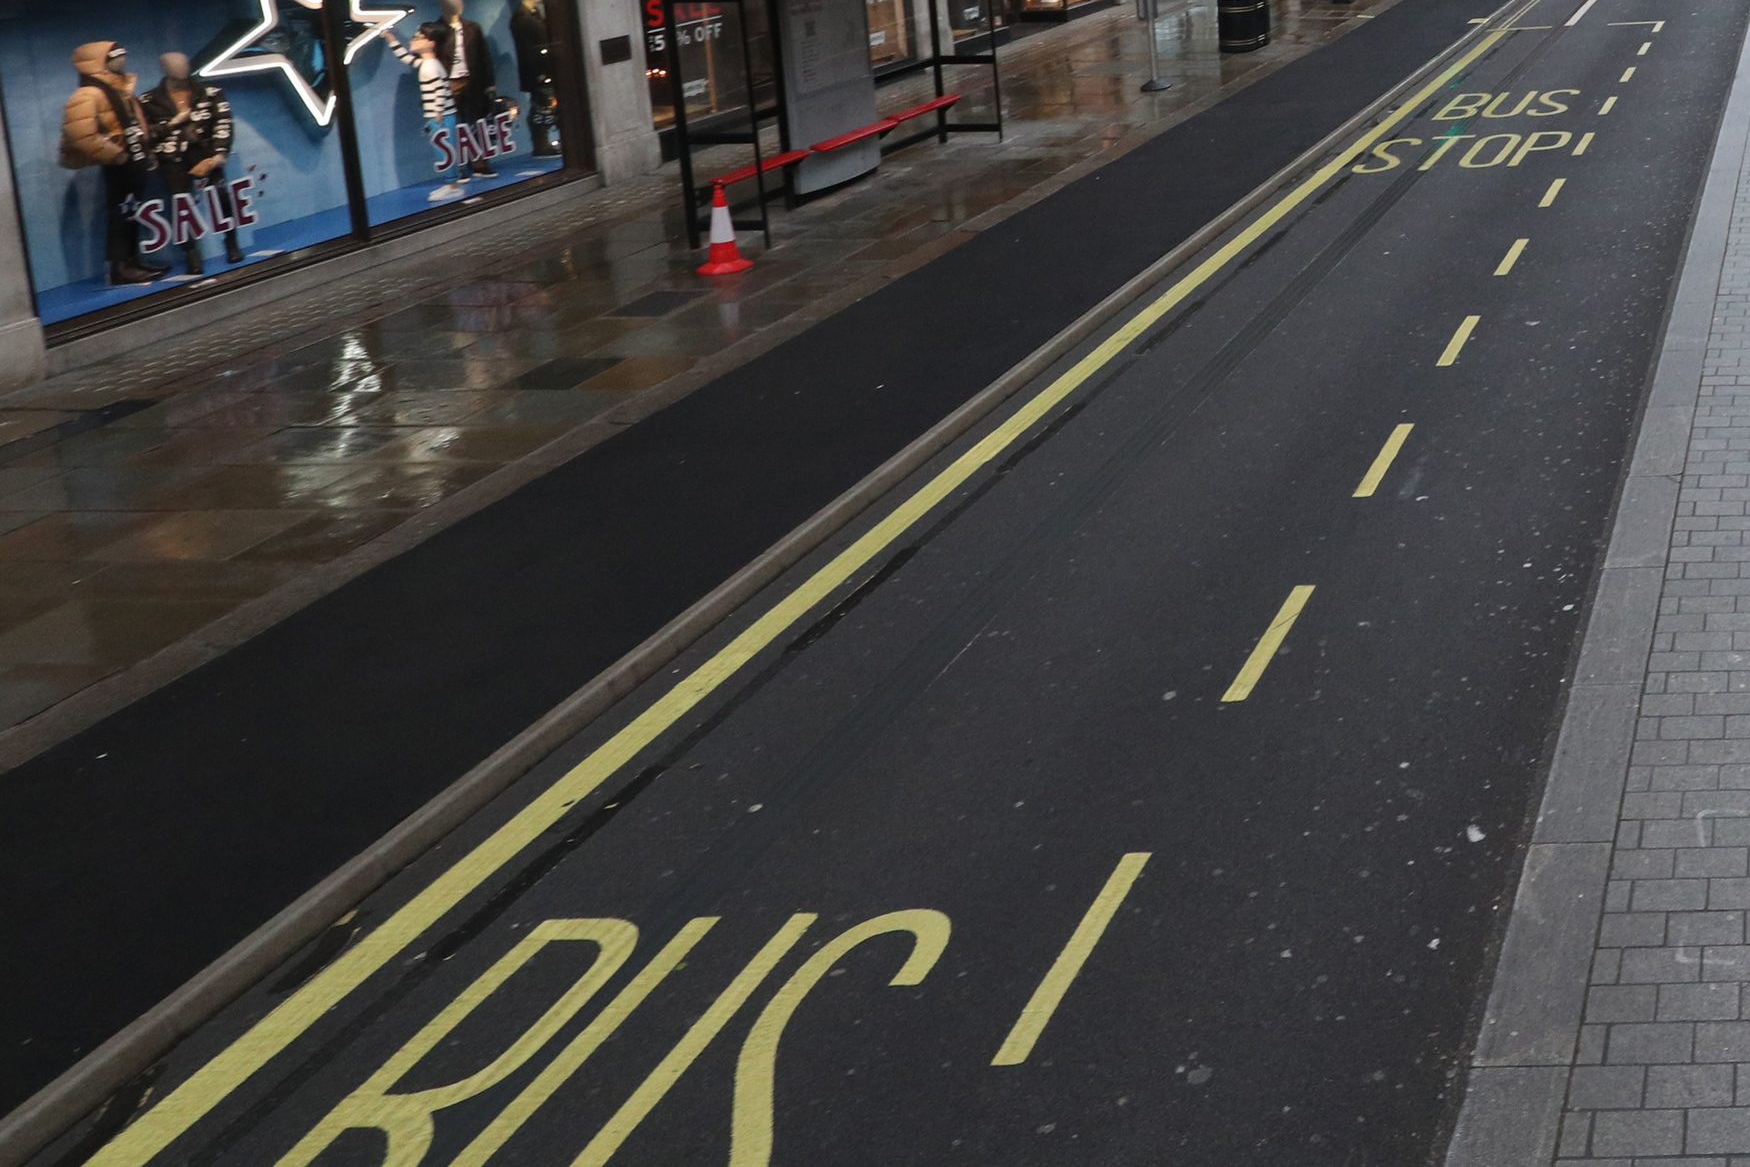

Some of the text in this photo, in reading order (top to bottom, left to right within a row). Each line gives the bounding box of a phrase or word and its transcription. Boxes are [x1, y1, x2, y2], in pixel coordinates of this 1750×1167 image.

[695, 23, 723, 42] OFF
[1431, 89, 1581, 122] BUS
[431, 111, 517, 173] SALE
[1351, 131, 1573, 174] STOP
[133, 175, 258, 254] SALE
